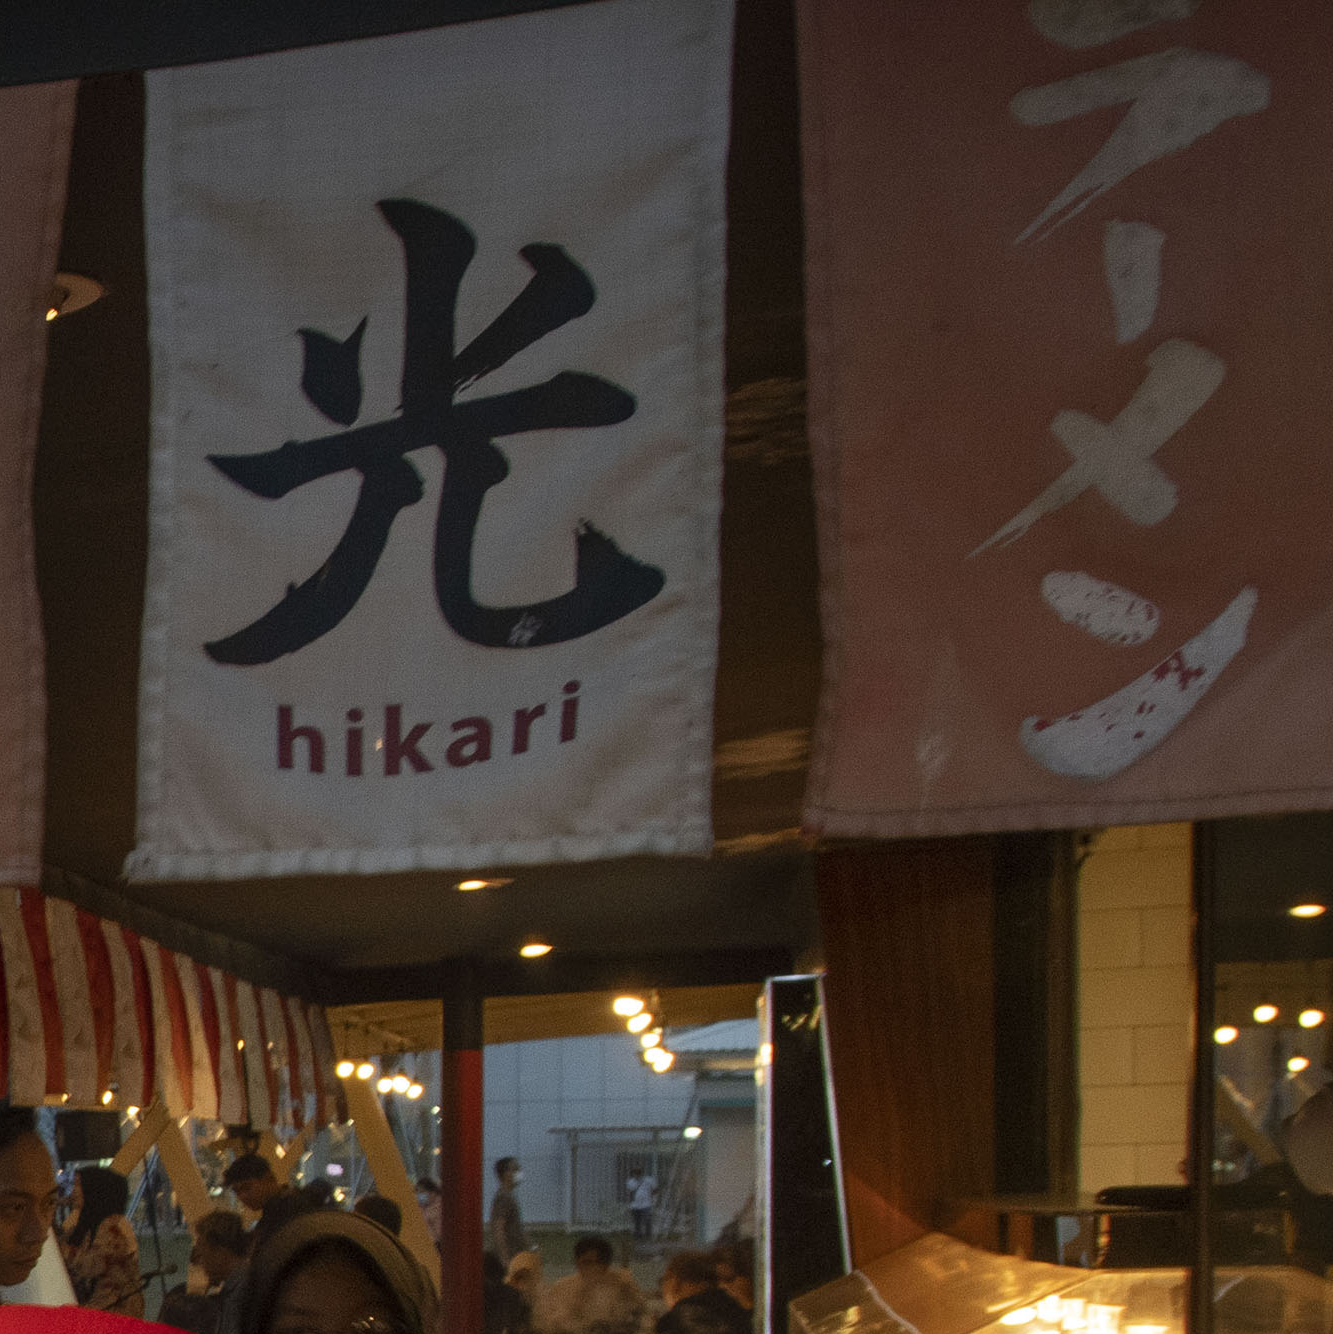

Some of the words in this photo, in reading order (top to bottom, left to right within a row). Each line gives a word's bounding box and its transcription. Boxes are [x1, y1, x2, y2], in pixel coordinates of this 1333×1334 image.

[202, 198, 666, 666] 光
[965, 0, 1271, 782] ラーメン
[275, 680, 581, 778] hikari
